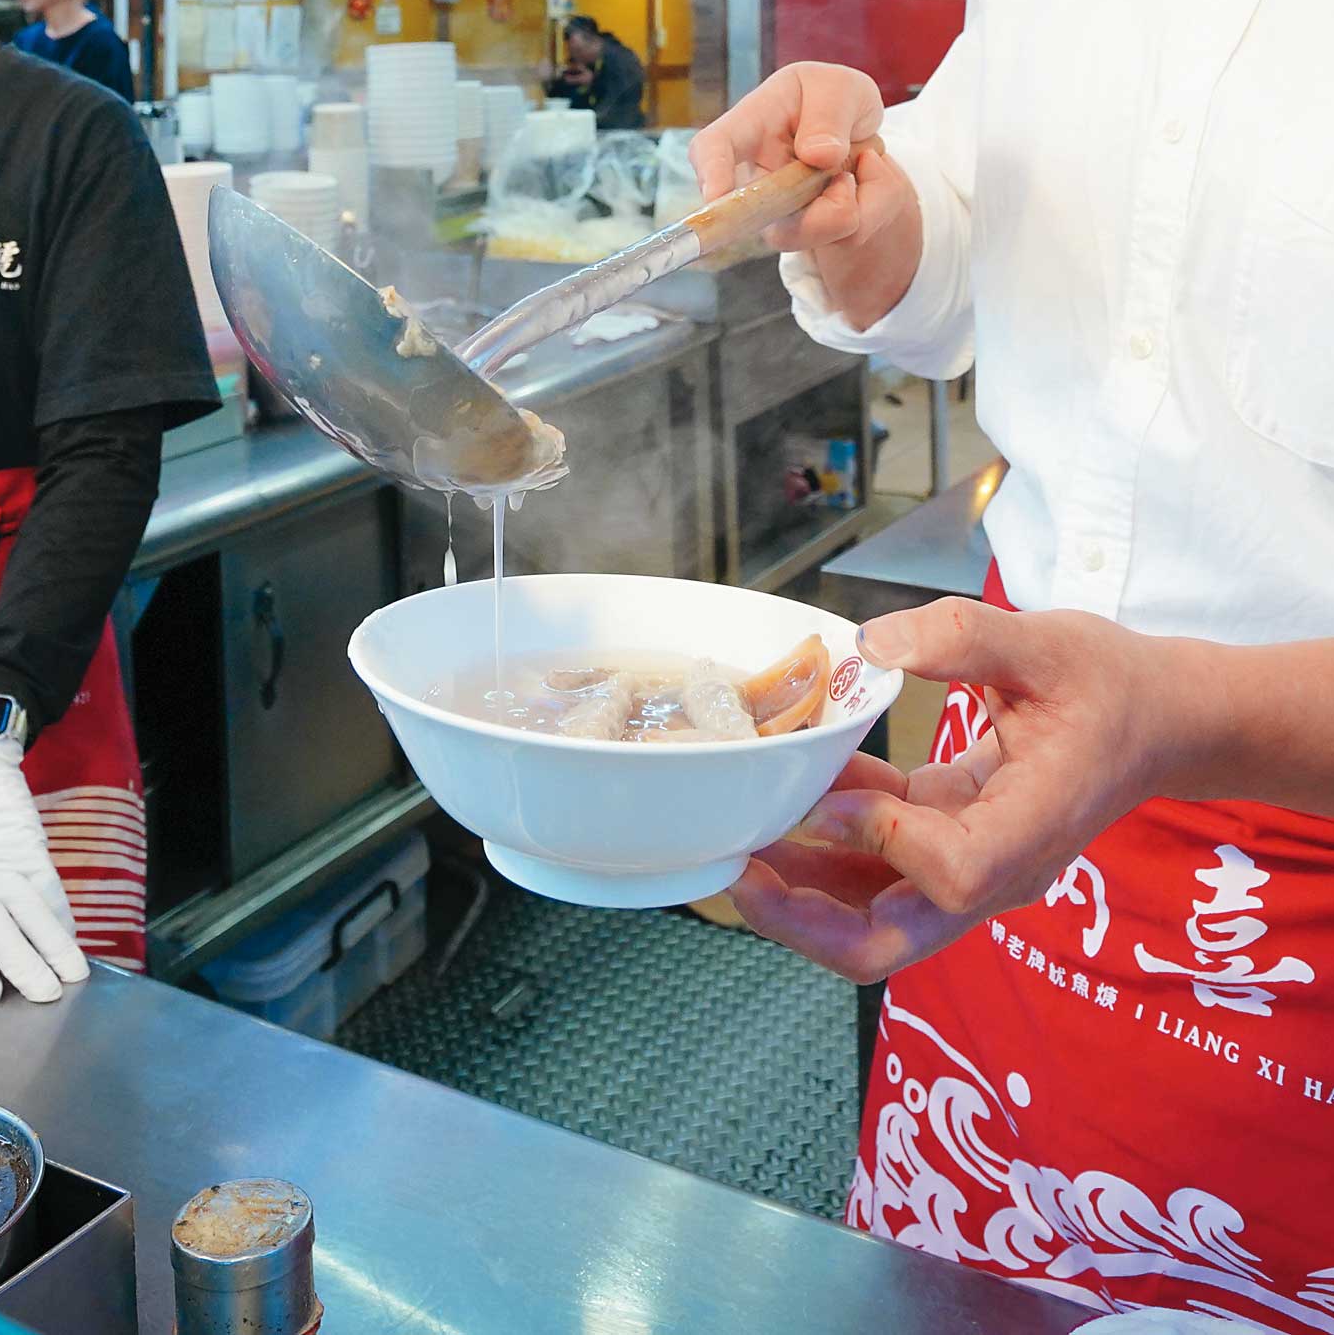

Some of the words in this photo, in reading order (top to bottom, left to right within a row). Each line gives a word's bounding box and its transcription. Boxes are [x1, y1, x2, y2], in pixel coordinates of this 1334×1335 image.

[986, 918, 1119, 1012] 舺老牌魷魚焿
[1156, 1011, 1242, 1063] LIANG
[1257, 1055, 1287, 1086] XI
